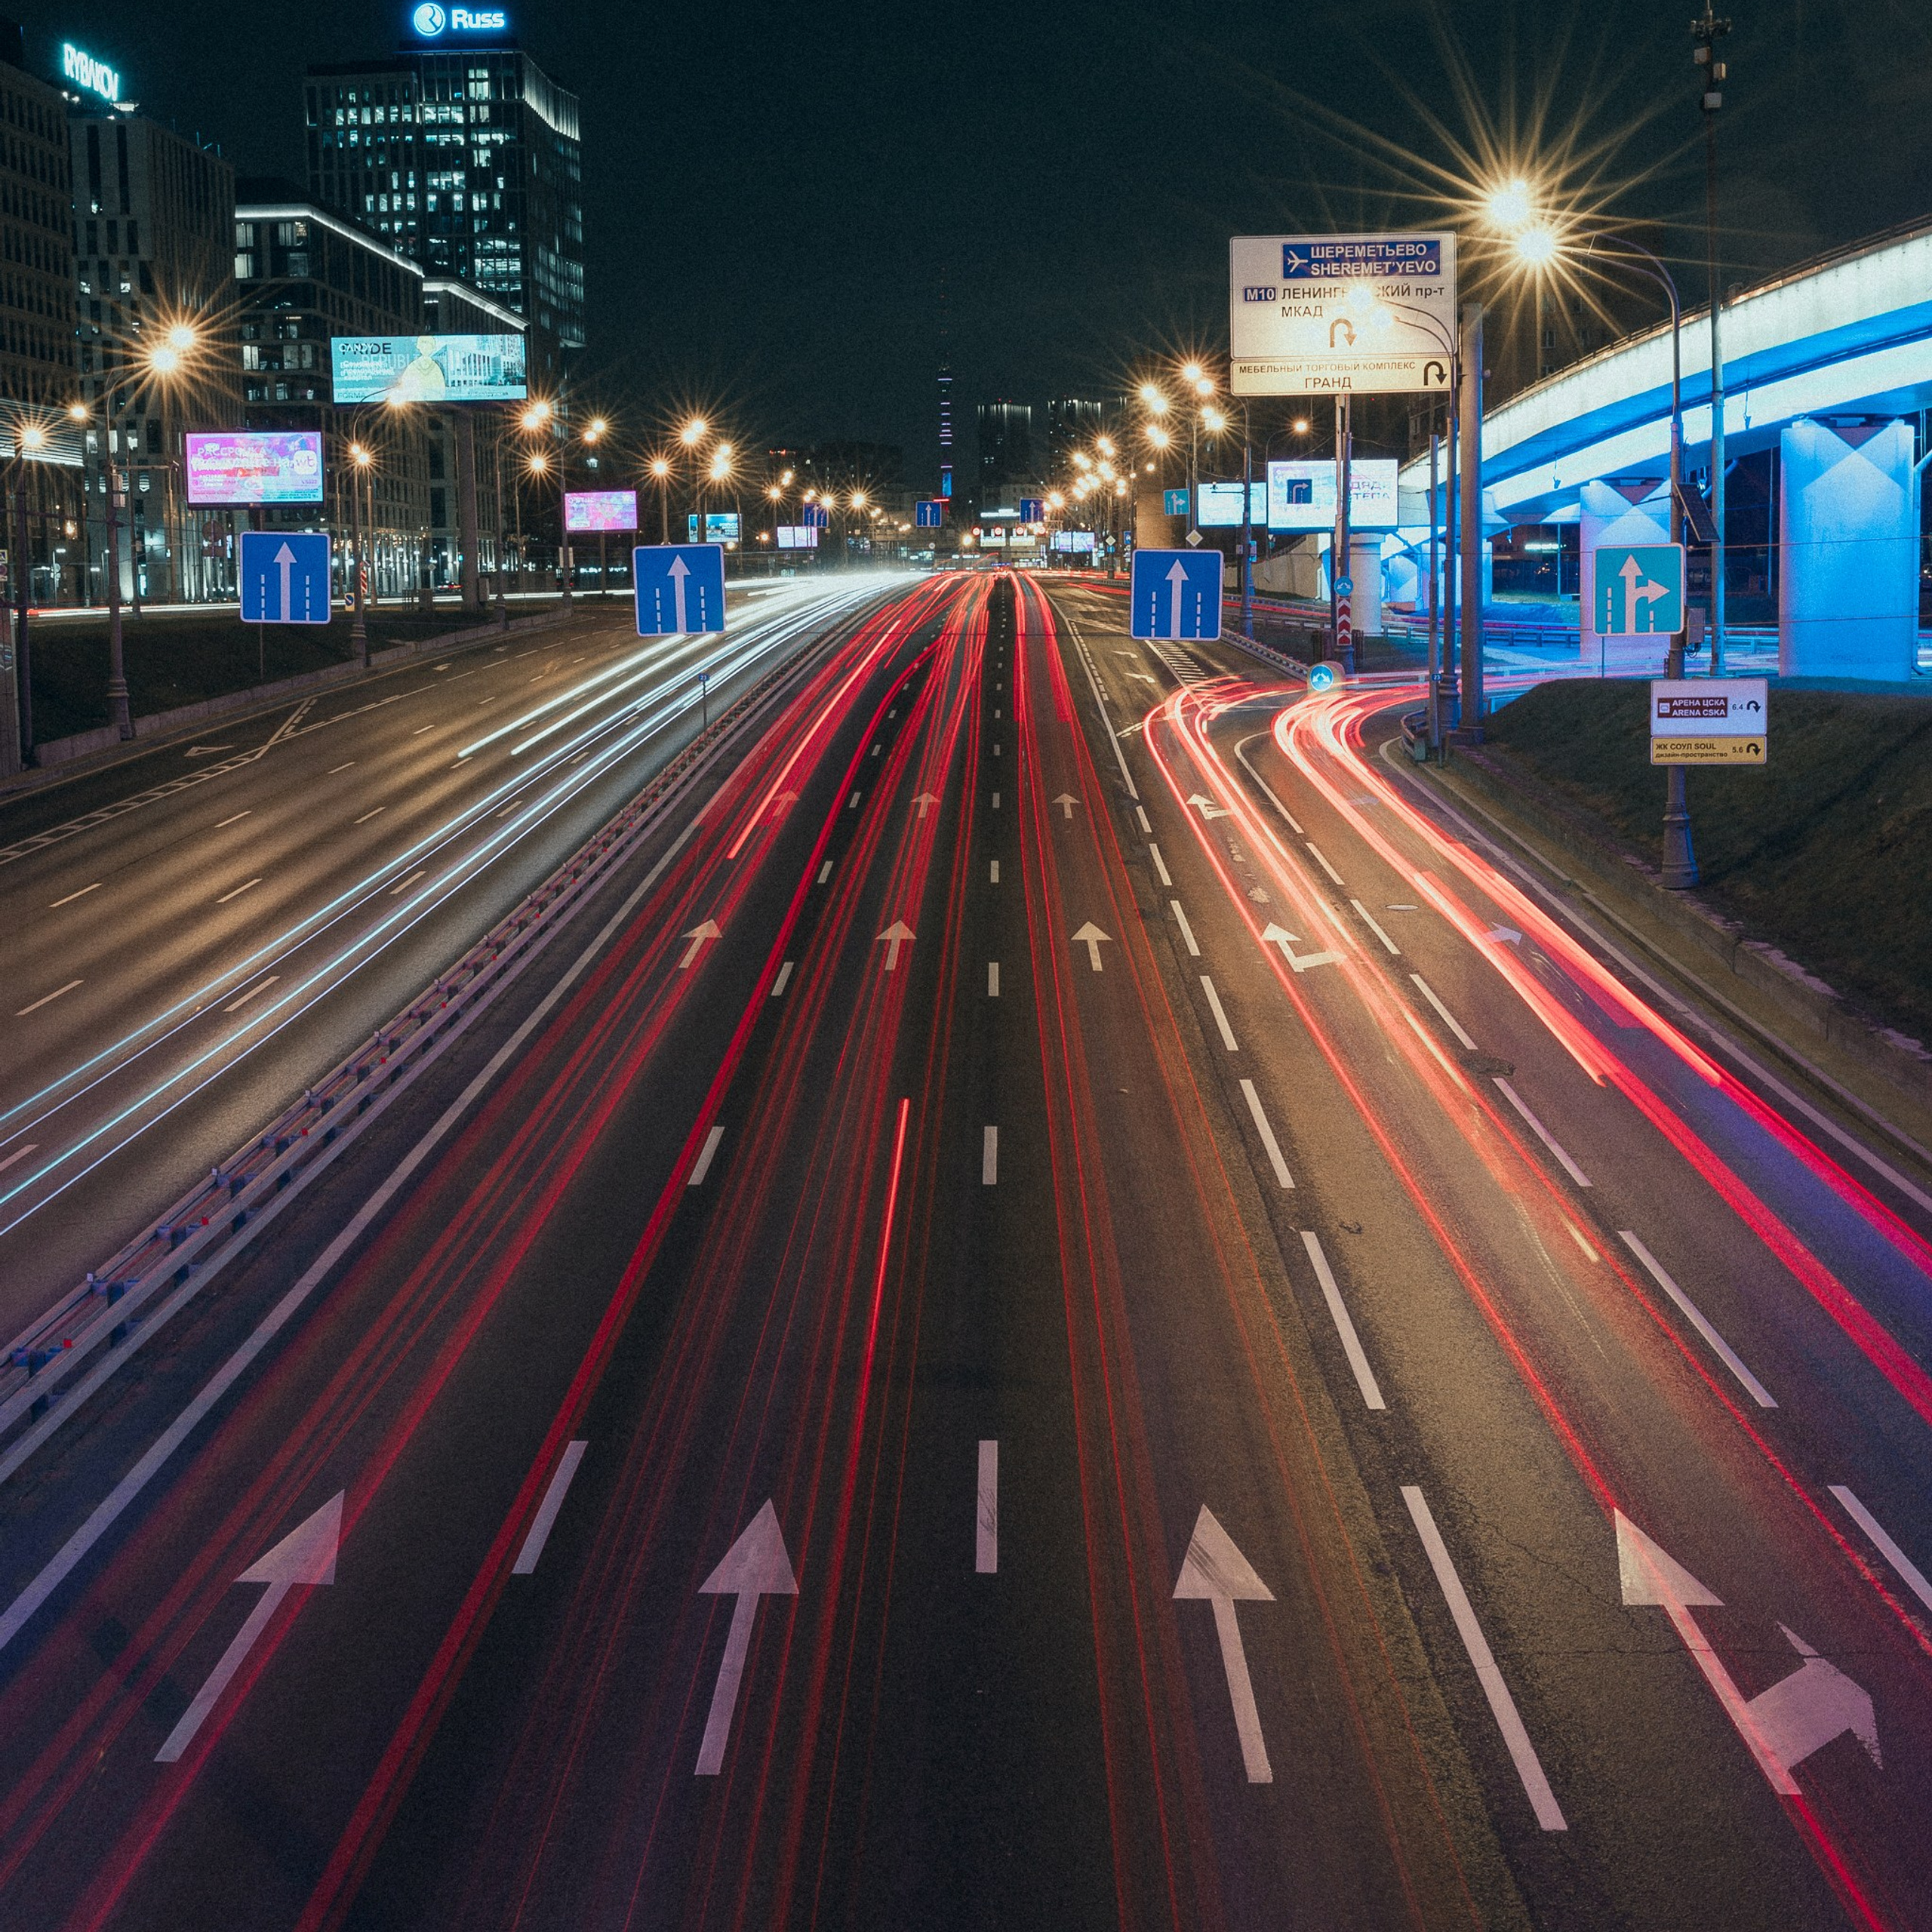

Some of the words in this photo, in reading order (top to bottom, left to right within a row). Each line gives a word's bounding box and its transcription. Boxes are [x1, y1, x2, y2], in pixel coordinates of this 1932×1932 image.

[451, 9, 505, 29] Russ
[1311, 243, 1427, 258] ШЕРЕМЕТЬЕВО
[1281, 283, 1411, 300] ЛЕНИНГРКИЙ
[1415, 287, 1445, 298] пр-т
[1281, 306, 1324, 318] МКАД
[1239, 364, 1303, 374] МЕБЕЛЬНЫЙ
[1306, 362, 1360, 372] ТОРГОВЫЙ
[1362, 361, 1416, 371] КОМПЛЕКС
[1305, 377, 1352, 389] ГРАНД
[1702, 699, 1726, 708] ЦСКА
